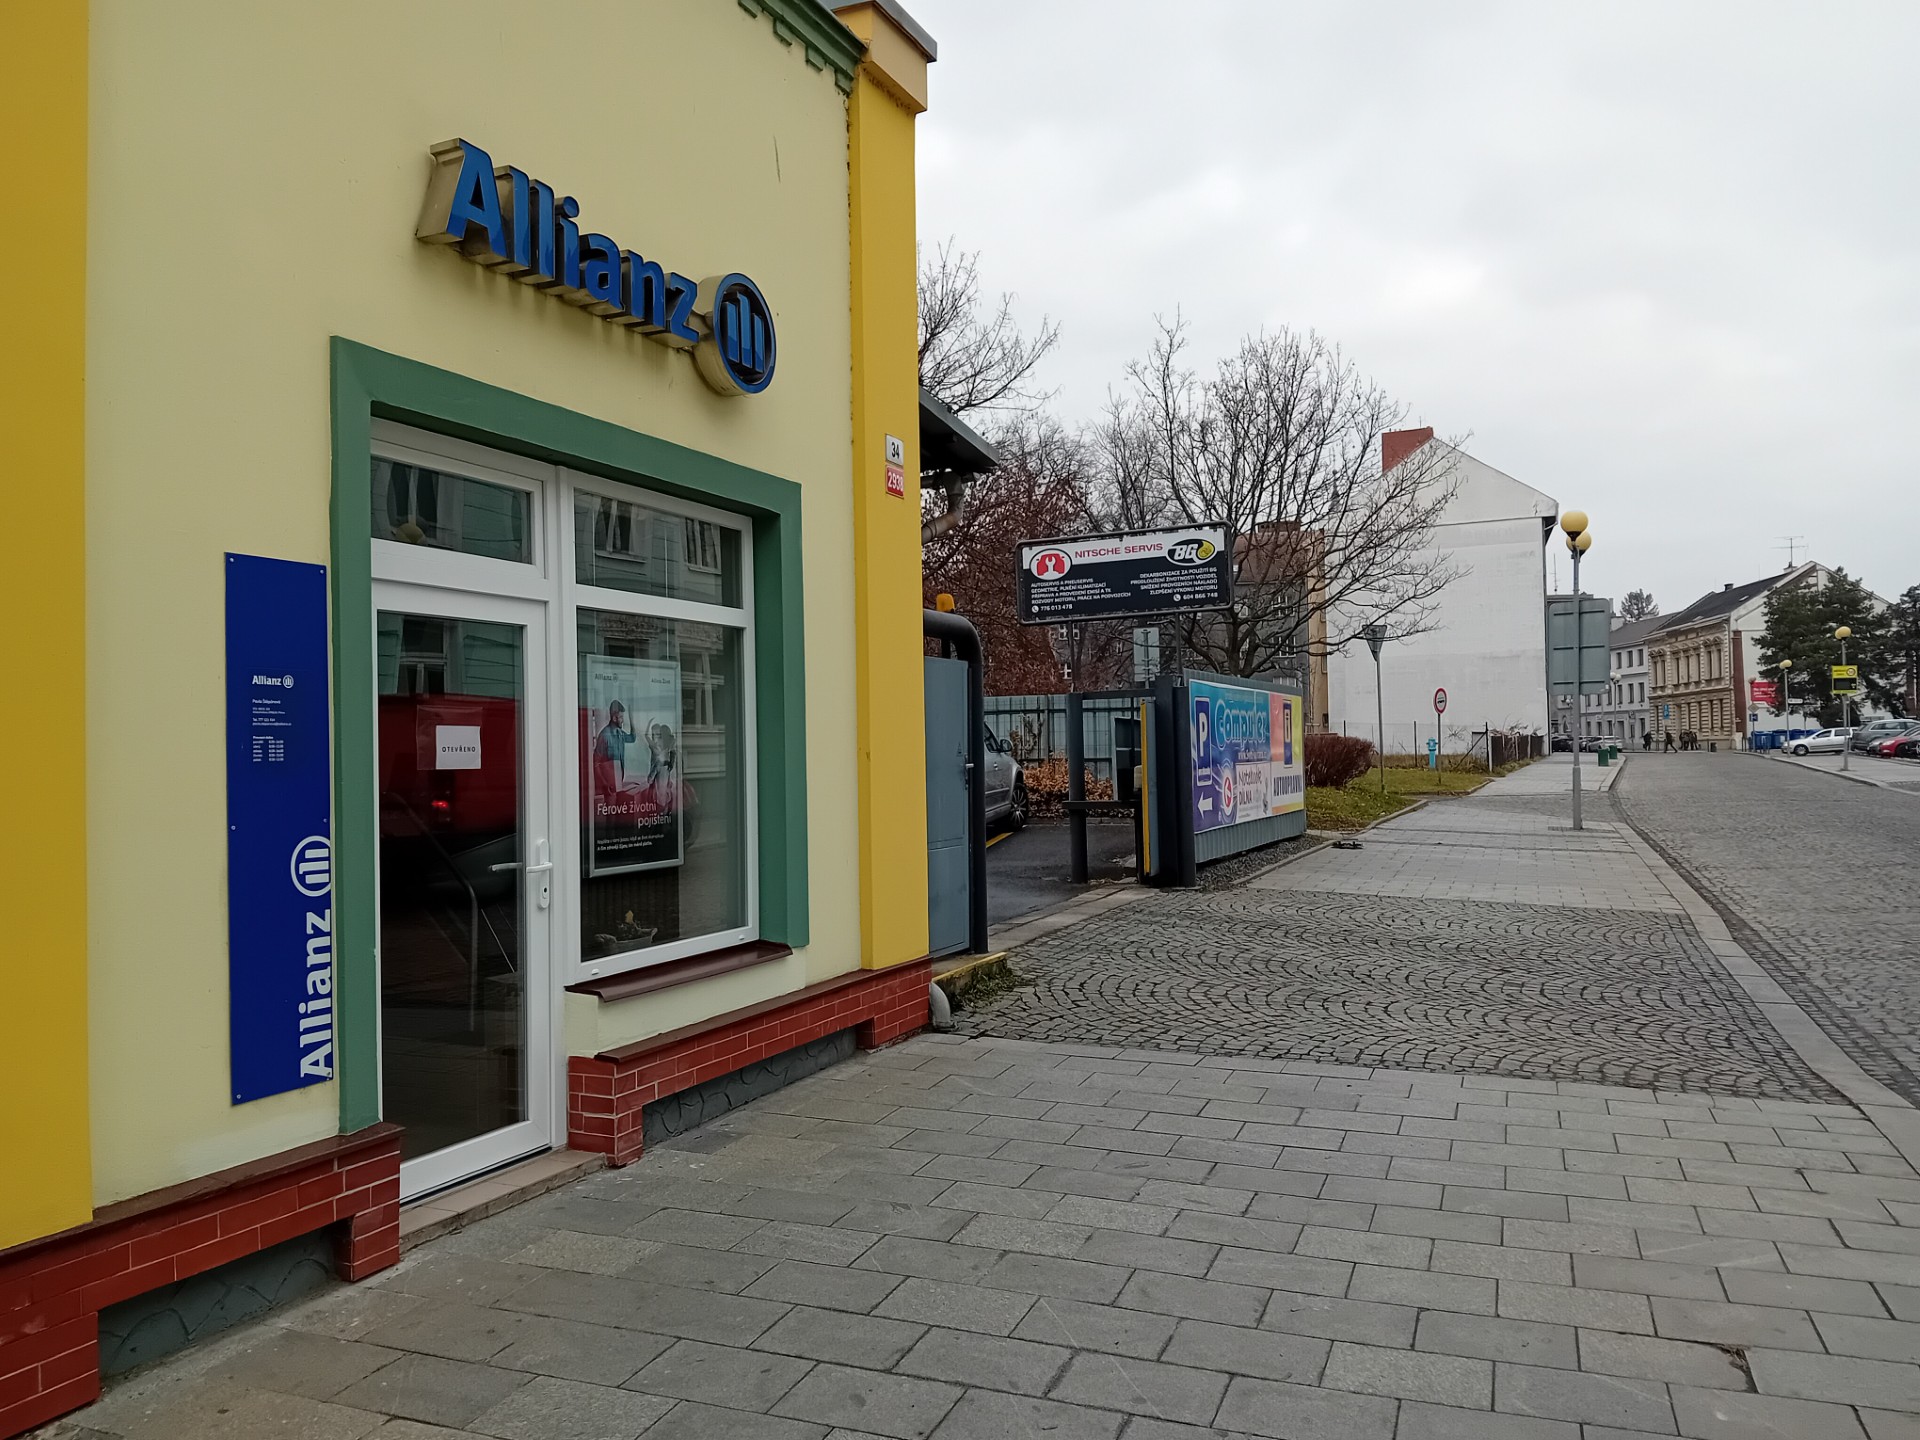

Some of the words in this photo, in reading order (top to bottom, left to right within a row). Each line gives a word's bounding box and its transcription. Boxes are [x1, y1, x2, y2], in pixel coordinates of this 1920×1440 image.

[446, 137, 699, 344] Allianz
[891, 442, 900, 459] 34
[1075, 547, 1121, 558] NITSCHE
[1124, 543, 1163, 554] SERVIS
[1174, 544, 1198, 560] BG
[252, 675, 282, 685] Allianz
[441, 745, 476, 753] OTEVŘENO
[597, 802, 628, 816] Férové
[629, 800, 657, 813] životní
[637, 812, 672, 829] pojištění
[299, 909, 333, 1078] Allianz
